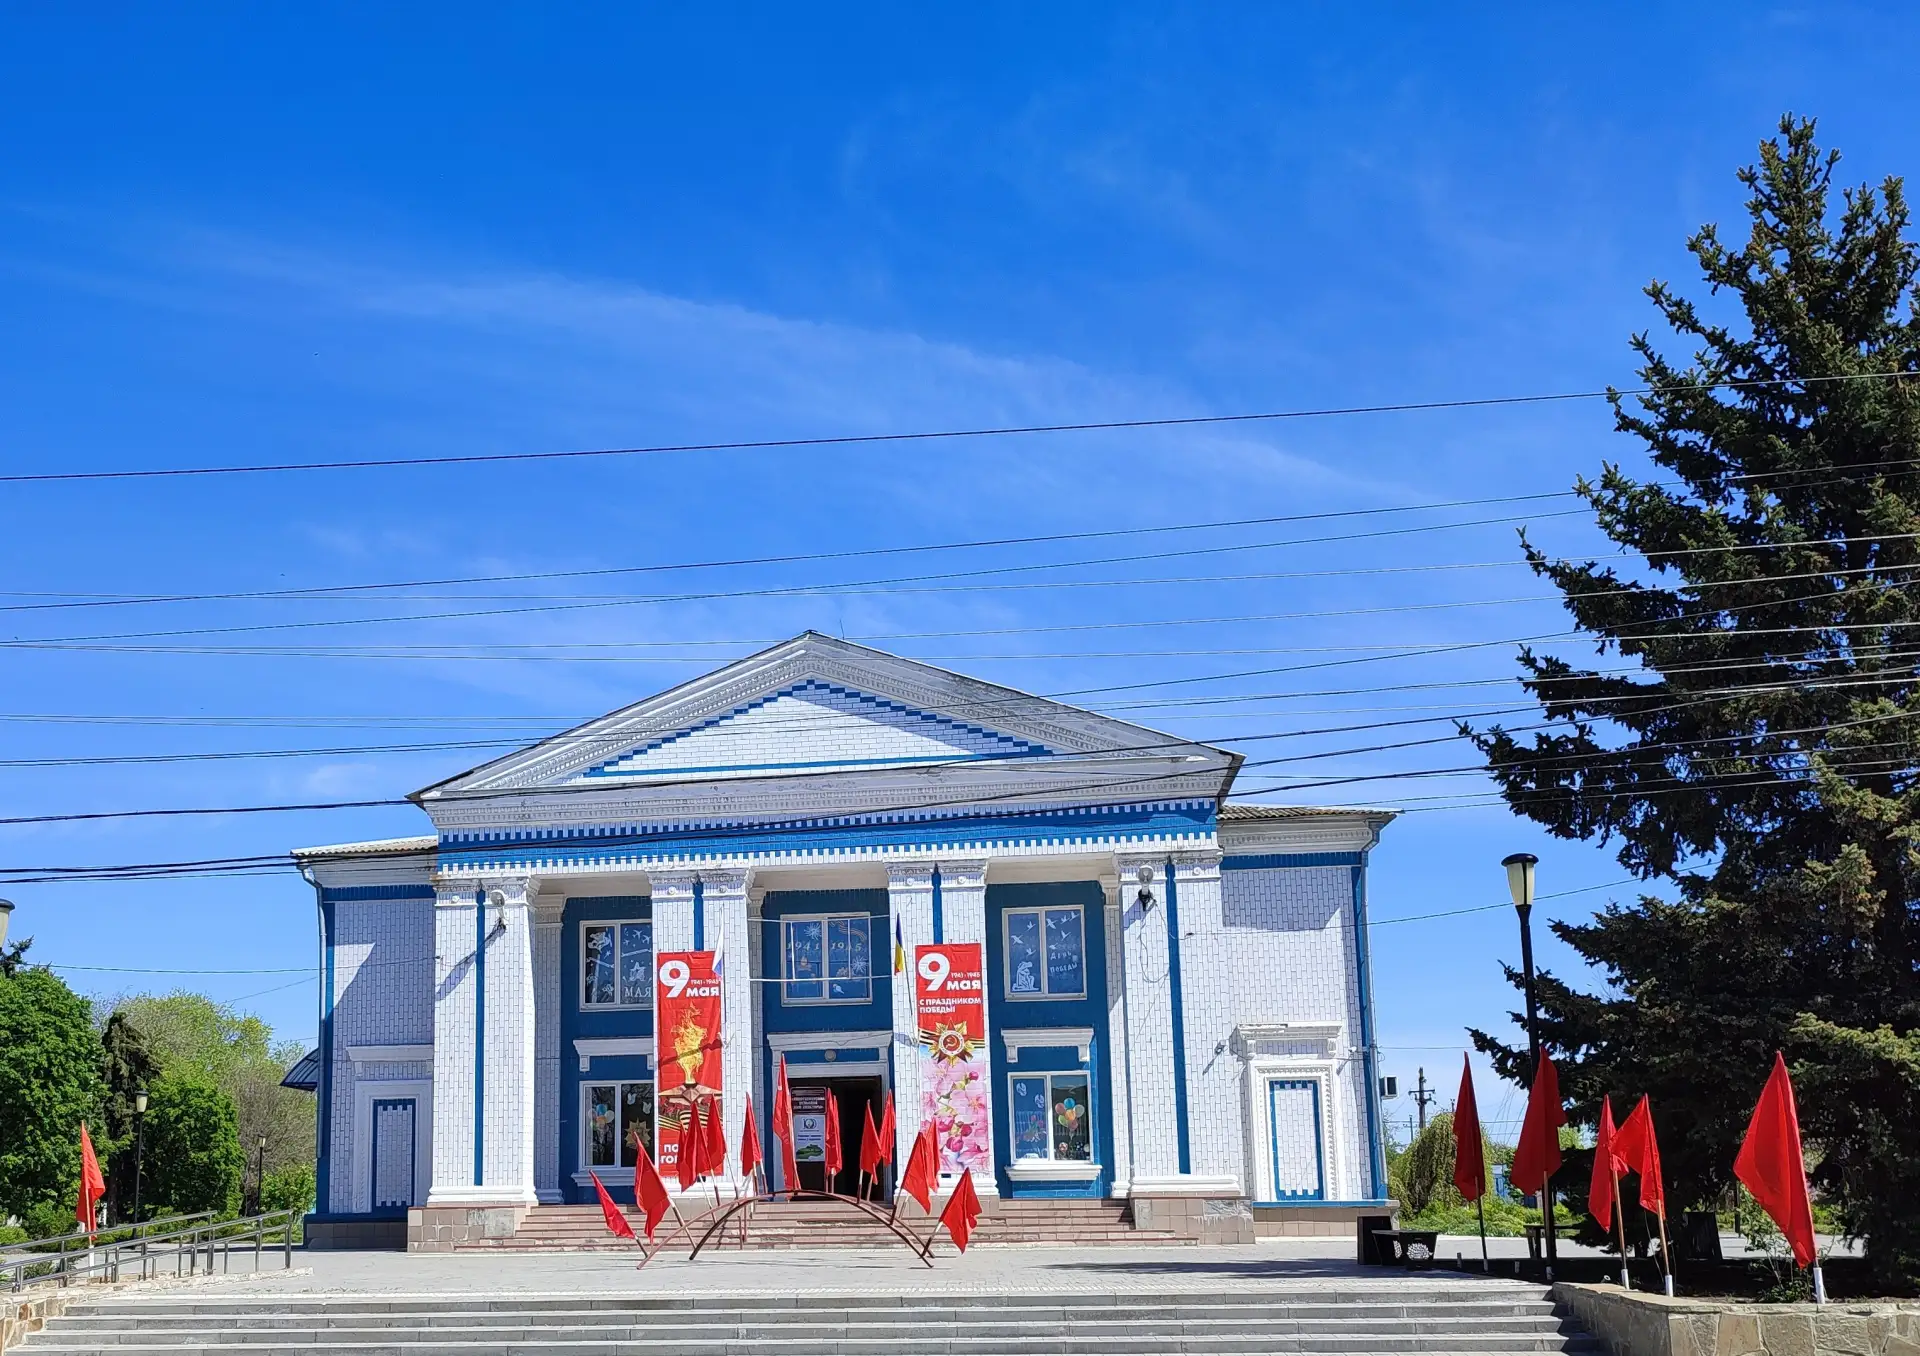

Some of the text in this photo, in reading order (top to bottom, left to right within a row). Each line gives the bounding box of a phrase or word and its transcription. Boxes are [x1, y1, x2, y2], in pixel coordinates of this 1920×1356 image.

[659, 960, 720, 998] 9 мая
[919, 952, 981, 991] 9 мая
[624, 986, 652, 997] МАЯ
[925, 997, 981, 1006] ПРАЗДНИКОМ
